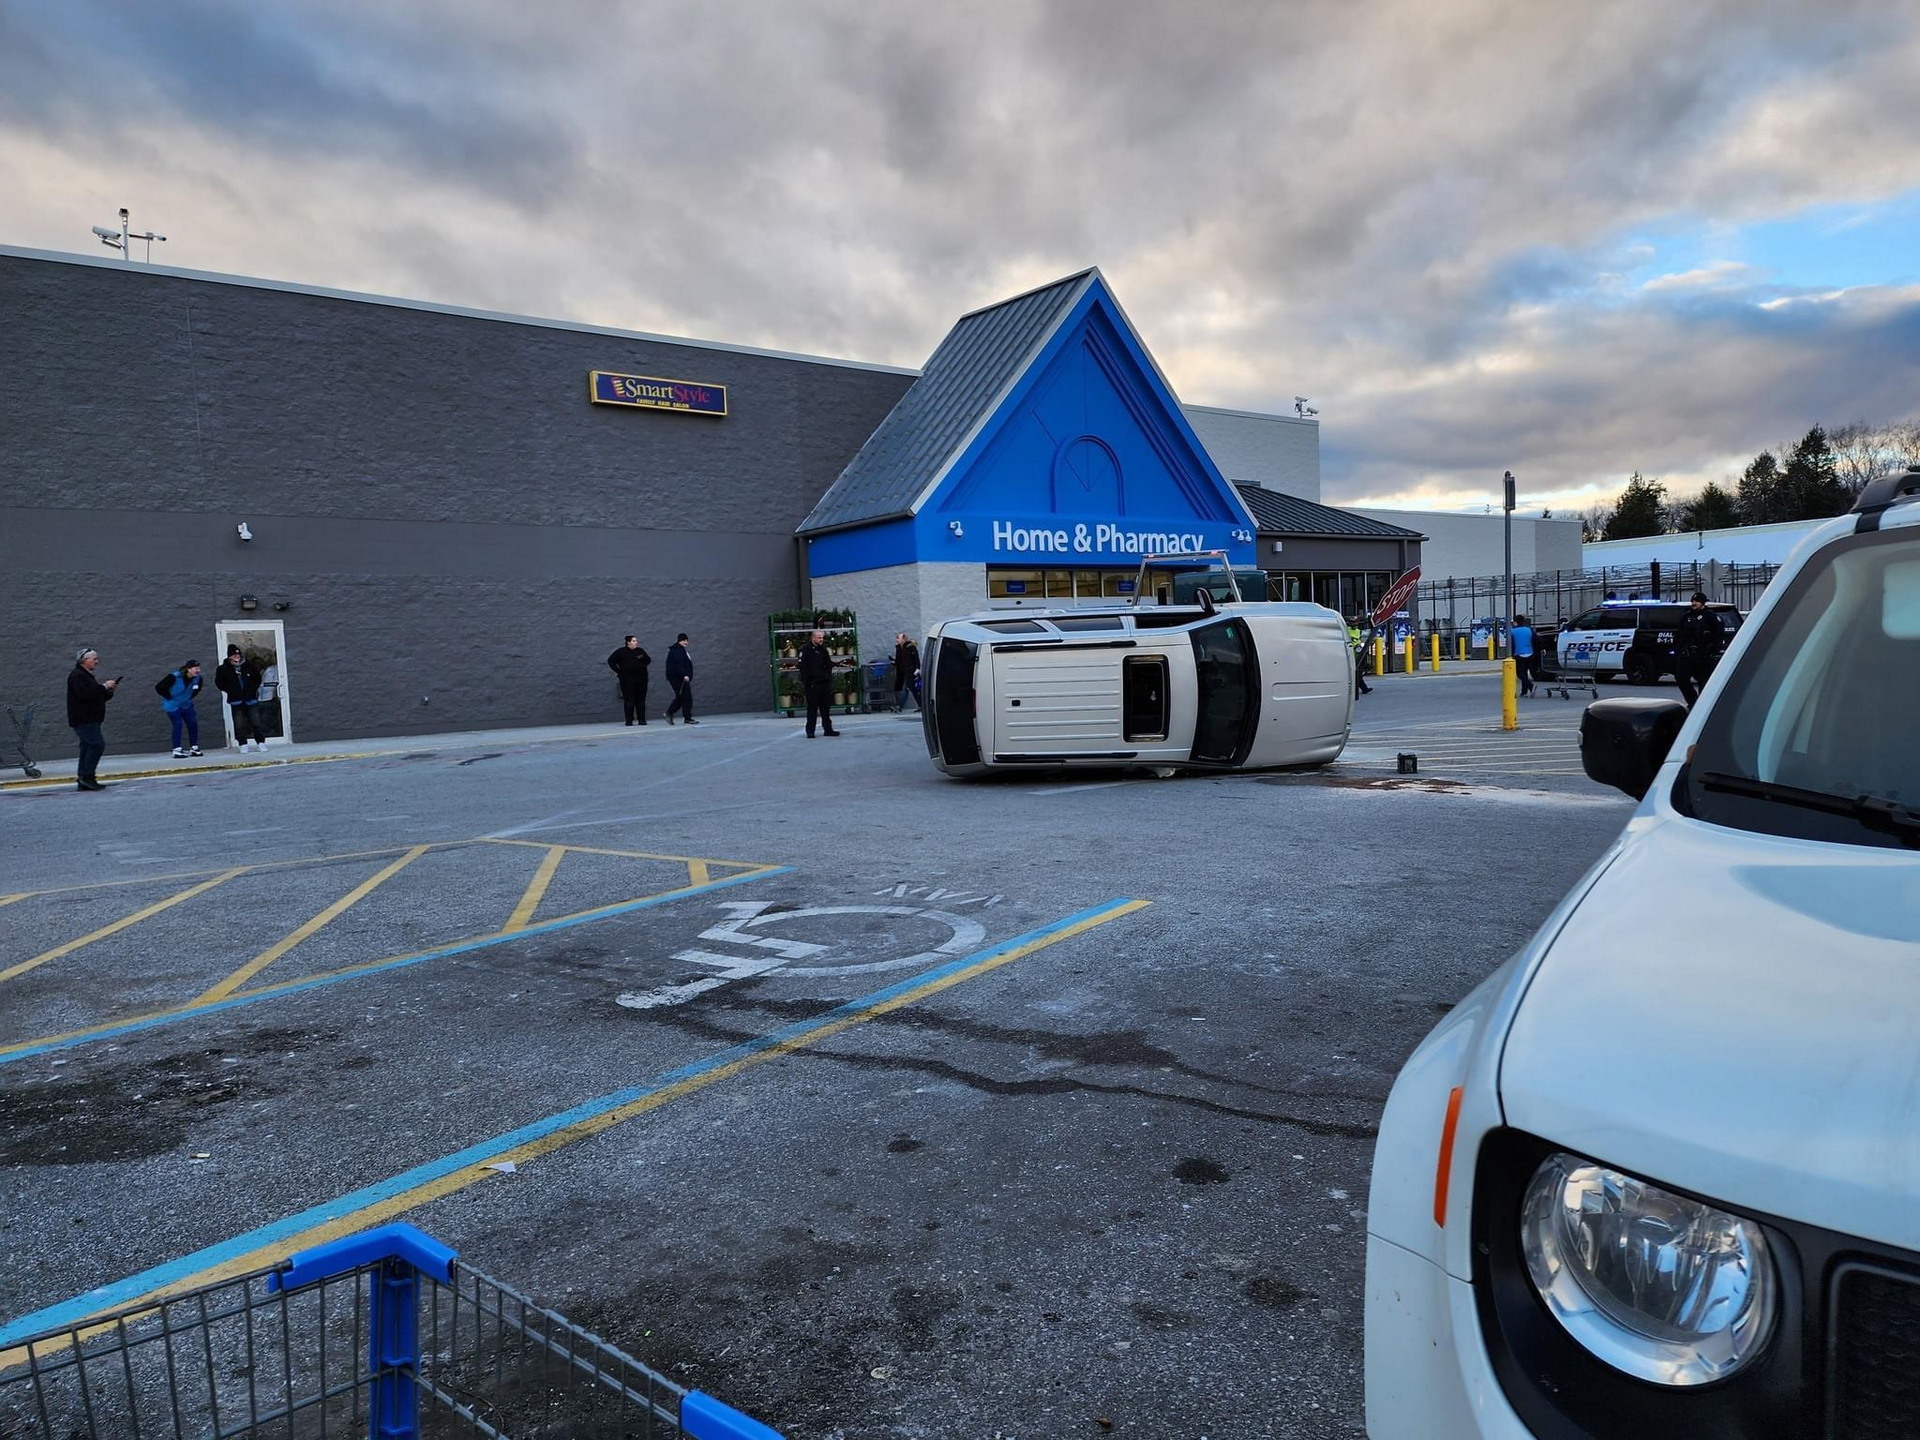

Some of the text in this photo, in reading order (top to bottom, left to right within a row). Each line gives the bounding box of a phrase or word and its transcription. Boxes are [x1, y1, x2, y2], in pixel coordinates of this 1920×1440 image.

[625, 378, 710, 403] SmartStyle
[992, 521, 1203, 553] Home & Pharmacy
[1377, 579, 1417, 615] STOP
[1567, 641, 1627, 652] POLICE
